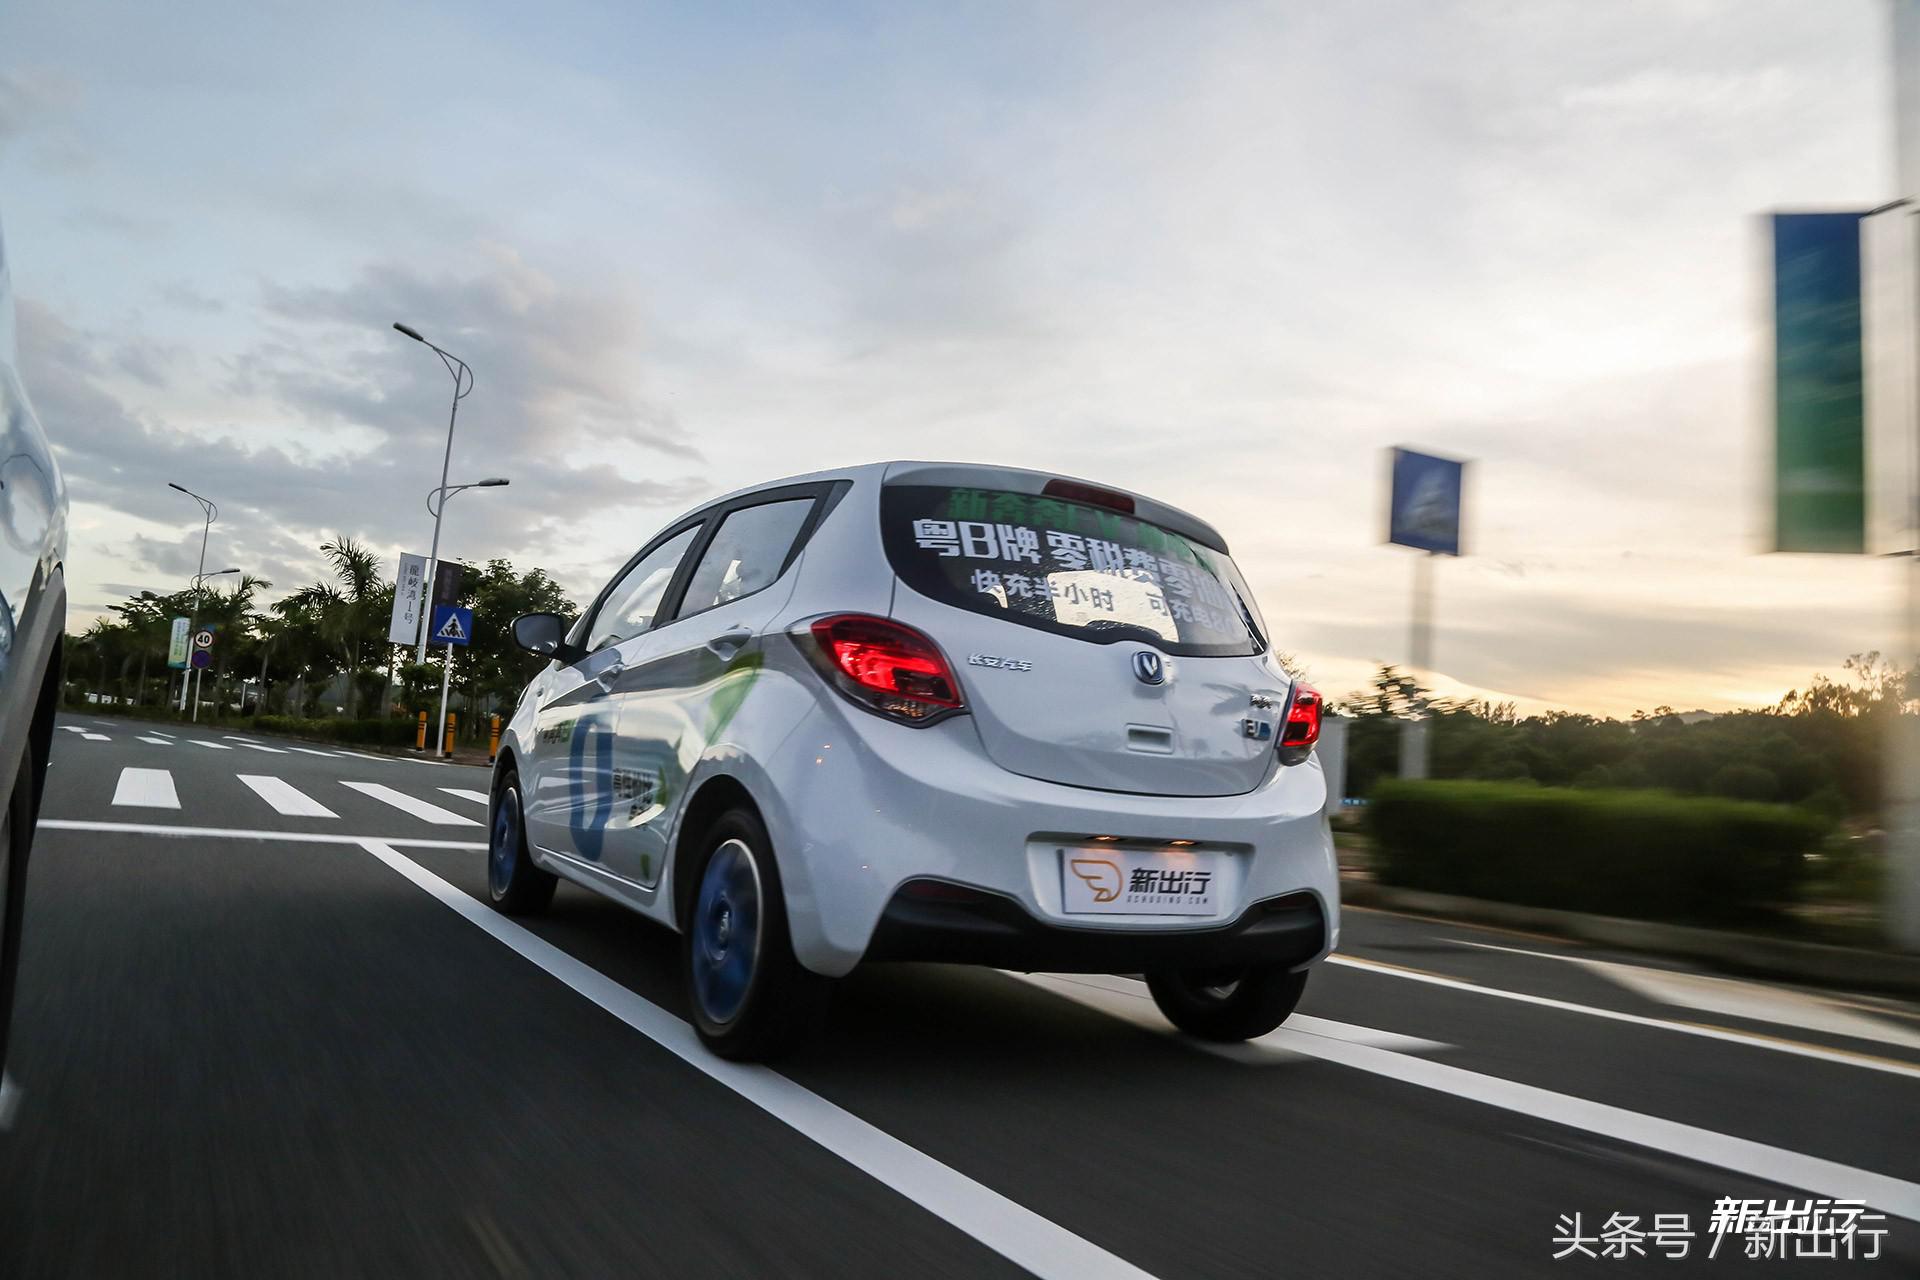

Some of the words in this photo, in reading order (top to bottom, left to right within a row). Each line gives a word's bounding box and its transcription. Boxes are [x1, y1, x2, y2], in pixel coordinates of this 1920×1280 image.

[197, 634, 211, 645] 40
[1128, 867, 1212, 896] 新出行
